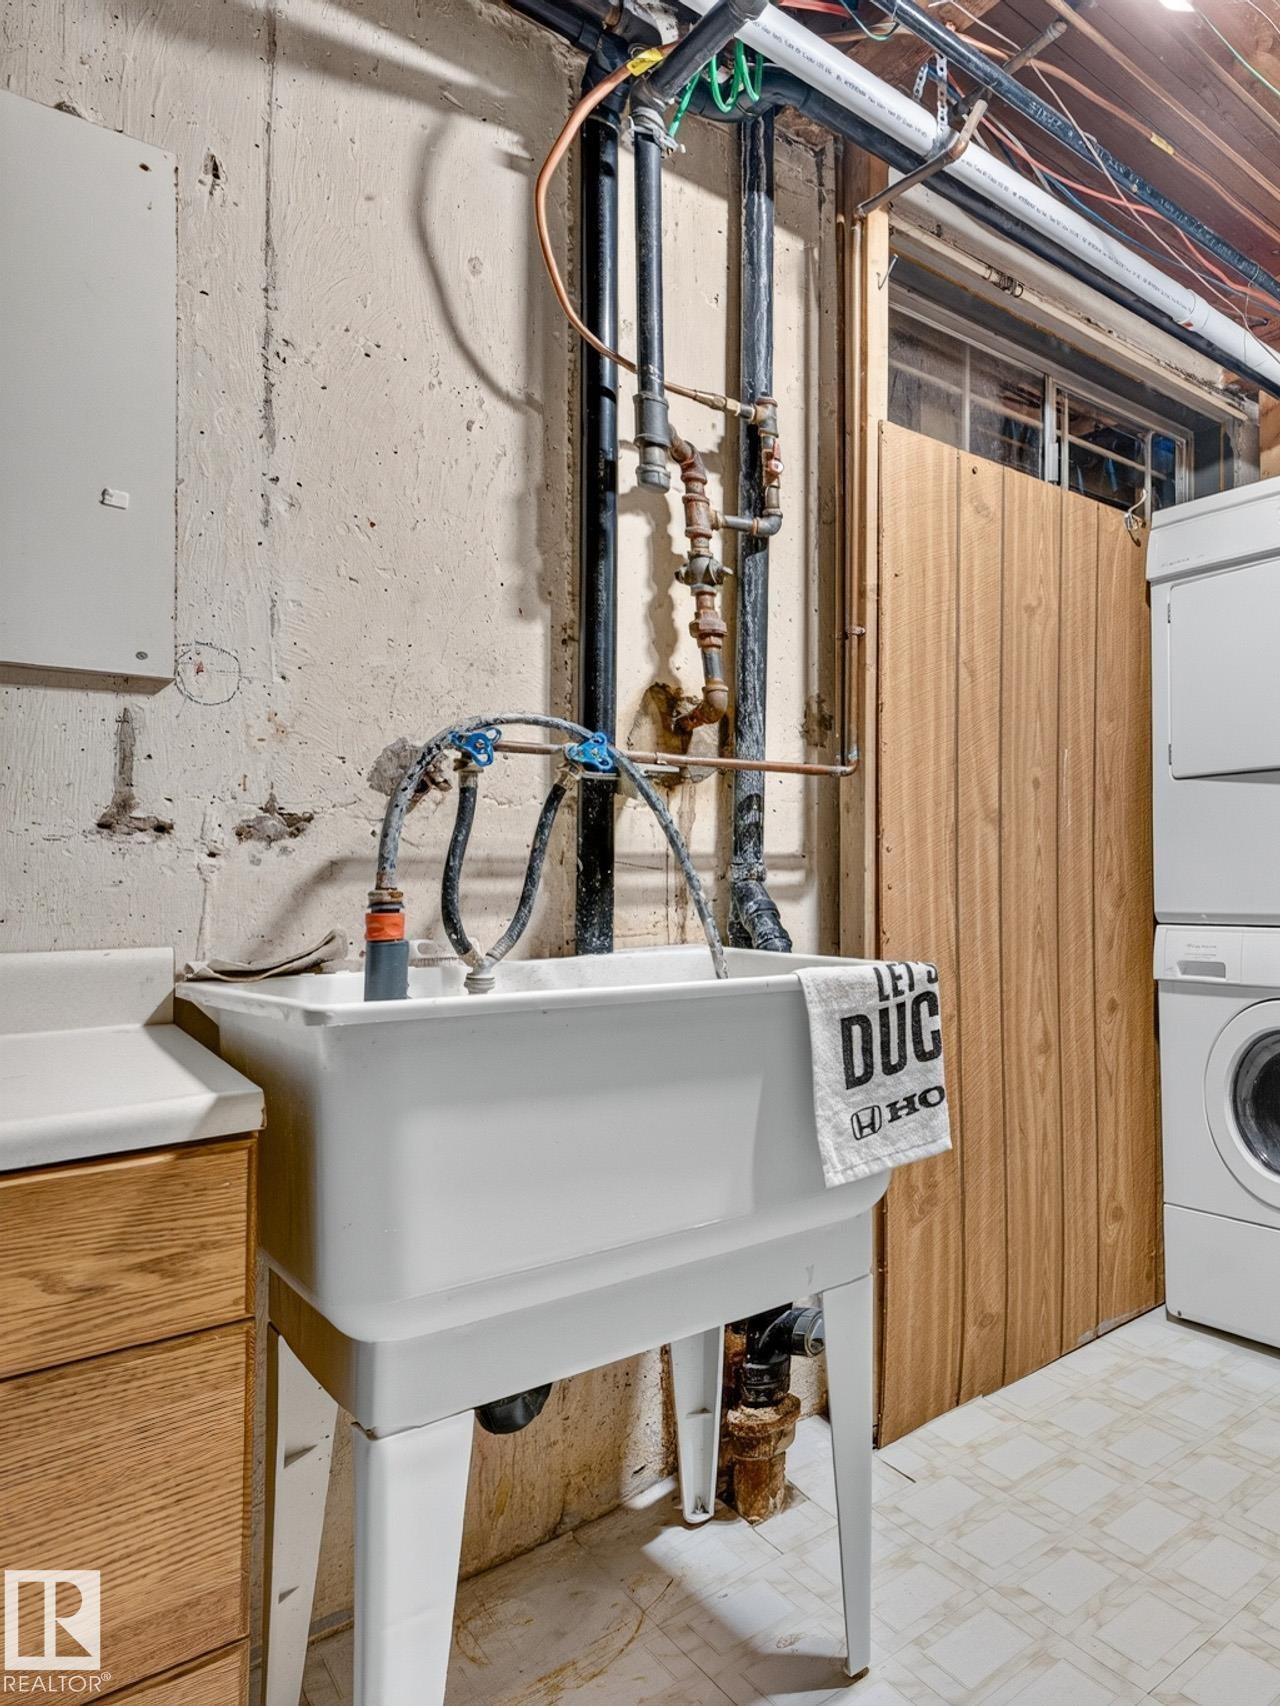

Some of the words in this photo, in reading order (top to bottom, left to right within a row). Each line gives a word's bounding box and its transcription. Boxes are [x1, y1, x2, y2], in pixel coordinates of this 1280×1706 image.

[873, 961, 939, 1003] LETS
[840, 990, 943, 1091] DUC
[885, 1085, 946, 1124] HO
